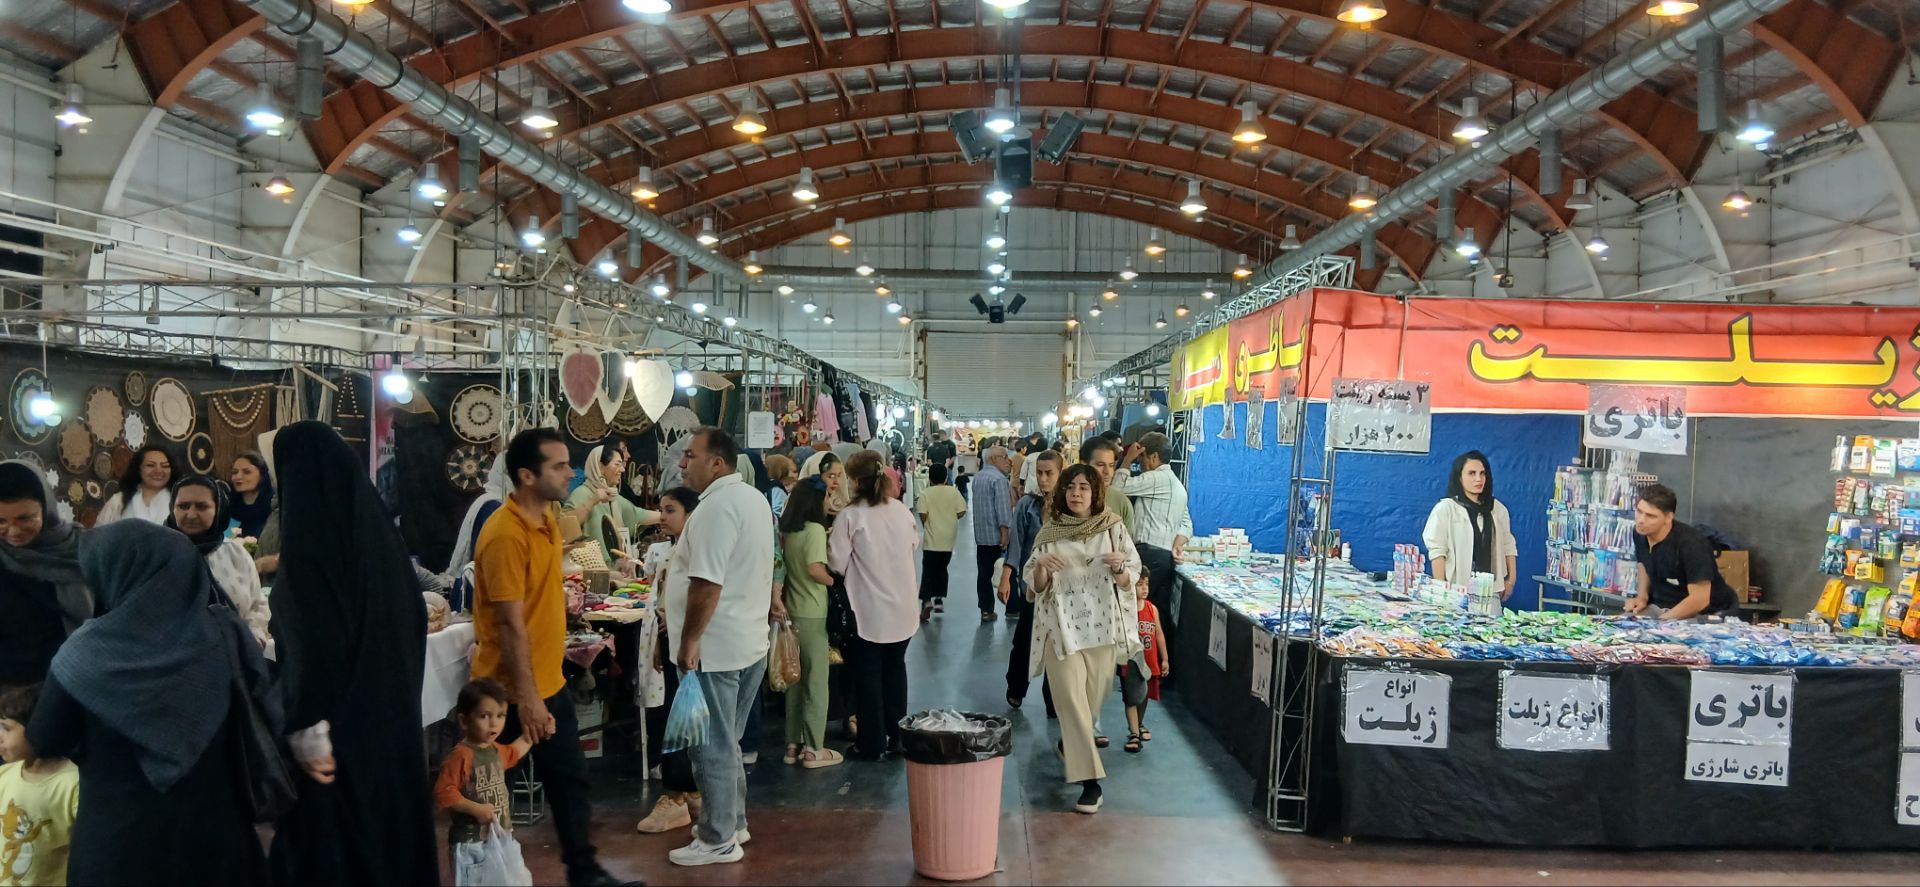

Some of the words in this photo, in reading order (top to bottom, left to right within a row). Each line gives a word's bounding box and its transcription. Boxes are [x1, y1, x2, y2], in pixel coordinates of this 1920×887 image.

[1234, 308, 1307, 395] باطری
[1589, 396, 1684, 440] باتری
[1344, 424, 1379, 446] هزار
[1383, 678, 1417, 699] انواع
[1508, 697, 1551, 728] ژیلت
[1556, 699, 1605, 730] انواع
[1694, 683, 1788, 729] باتری
[1358, 702, 1438, 744] ژیلت
[1691, 757, 1740, 778] شارژی
[1743, 760, 1784, 782] باتری
